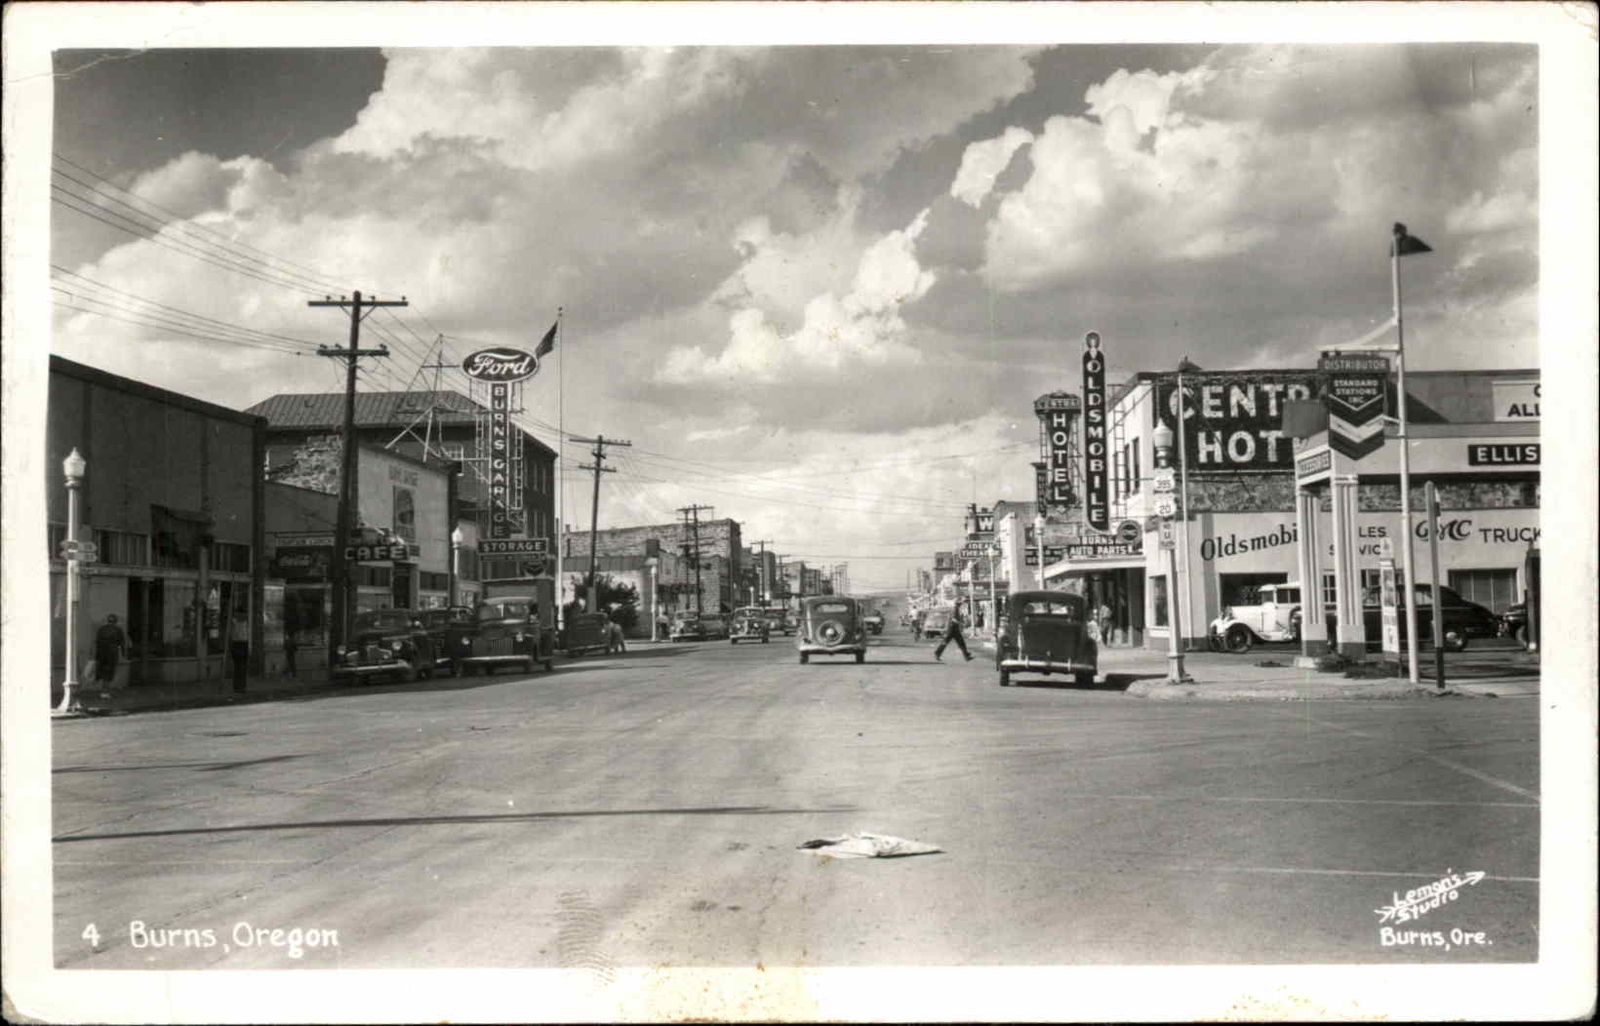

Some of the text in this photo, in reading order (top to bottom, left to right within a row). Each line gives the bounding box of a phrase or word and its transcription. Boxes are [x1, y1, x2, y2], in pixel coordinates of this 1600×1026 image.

[467, 351, 532, 376] Ford
[1324, 358, 1386, 370] DISTRIBUTOR
[1335, 388, 1377, 396] STATIONS
[1087, 360, 1104, 522] OLDSMOBILE
[1053, 413, 1067, 500] HOTEL
[1477, 446, 1538, 462] ELLIS
[493, 386, 505, 537] BURNS GARAGE
[1156, 480, 1171, 489] 395
[1159, 506, 1171, 514] 20
[483, 541, 543, 552] STORAGE
[1069, 547, 1093, 555] AUTO
[1097, 546, 1126, 554] PARTS
